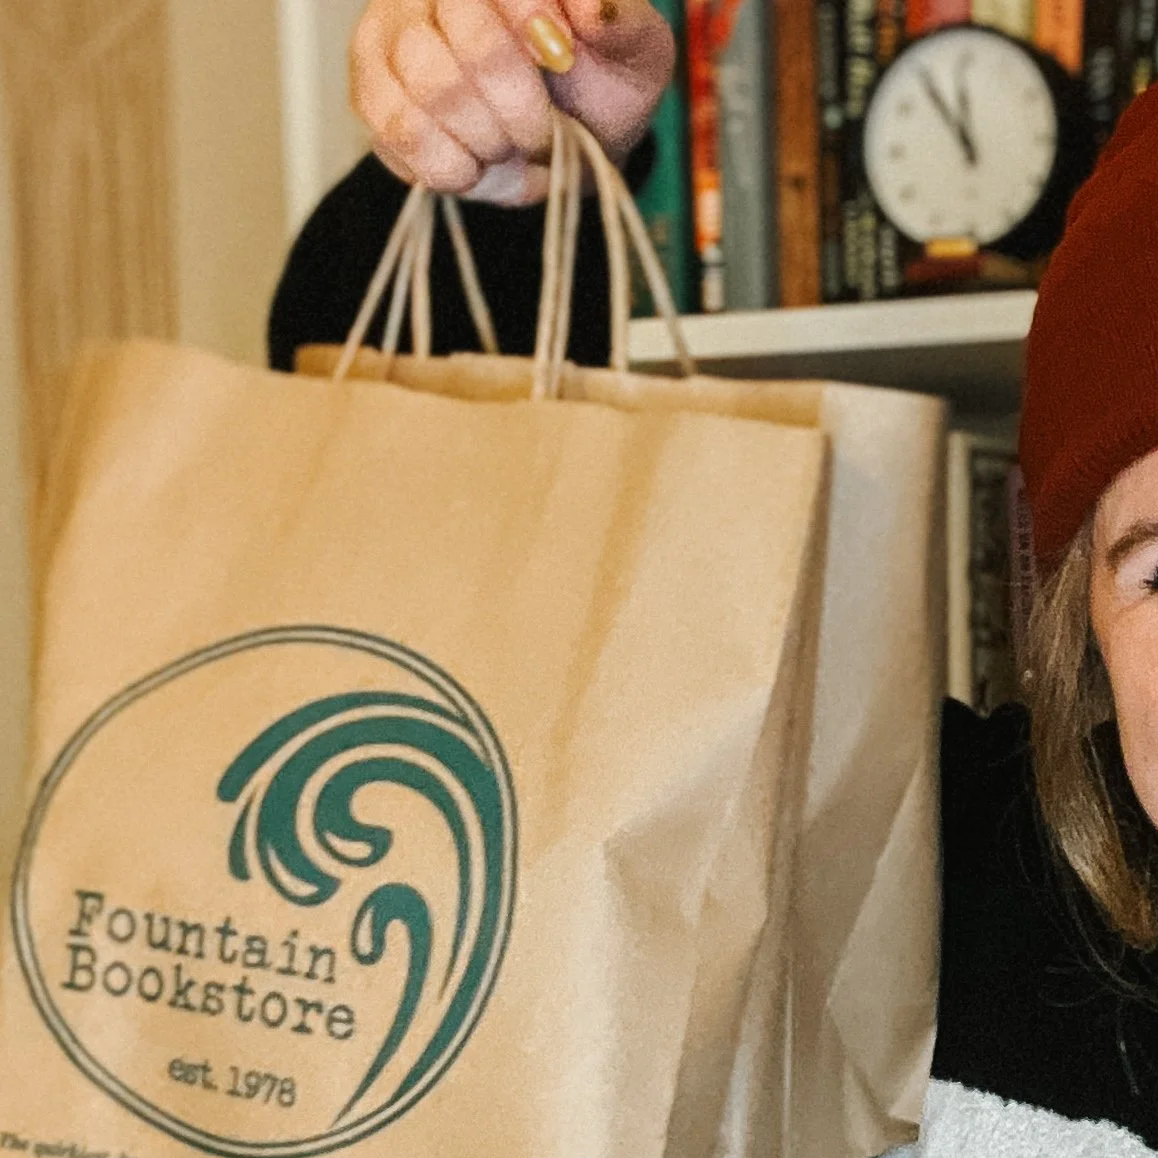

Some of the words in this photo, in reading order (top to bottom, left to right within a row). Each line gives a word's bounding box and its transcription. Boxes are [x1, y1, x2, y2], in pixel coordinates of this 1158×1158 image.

[69, 889, 336, 984] Fountain
[61, 943, 355, 1040] Bookstore
[225, 1066, 296, 1107] 1978
